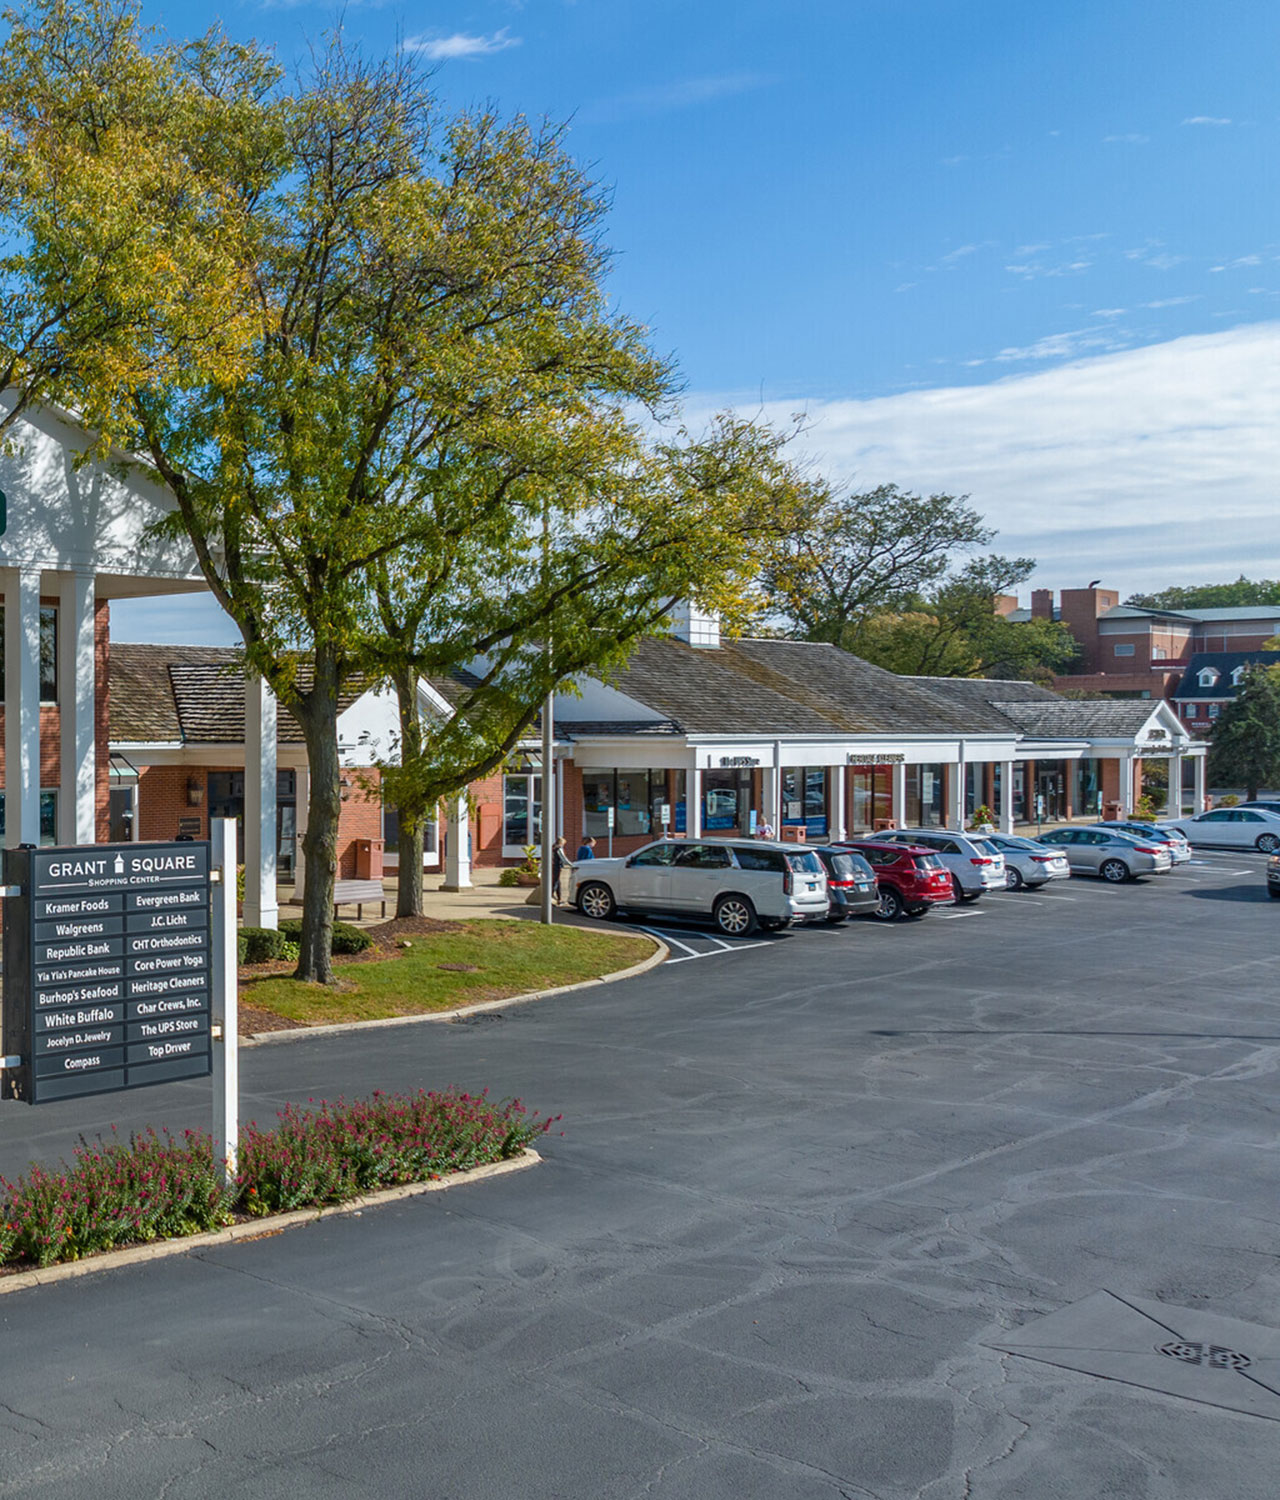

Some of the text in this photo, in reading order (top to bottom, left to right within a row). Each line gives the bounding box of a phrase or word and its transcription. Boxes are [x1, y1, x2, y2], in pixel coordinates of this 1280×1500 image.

[49, 855, 196, 877] GRANT SQUARE
[88, 875, 160, 887] SHOPPING CENTER
[45, 899, 109, 914] Kramer Foods
[136, 891, 200, 907] Evergreen Bank
[151, 914, 187, 927] J.C. Licht
[55, 923, 104, 937] Walgreens
[132, 934, 202, 950] CHT Orthodontics
[46, 942, 110, 960] Republic Bank
[134, 955, 203, 971] Core Power Yoga
[37, 966, 120, 982] Yia Yia's Pancake House
[131, 976, 205, 993] Heritage Cleaners
[39, 985, 118, 1004] Burhop's Seafood
[137, 997, 202, 1014] Char Crews, Inc.
[45, 1008, 114, 1028] White Buffalo
[141, 1019, 198, 1036] The UPS Store
[46, 1030, 112, 1048] Jocelyn D. Jewelry
[148, 1042, 191, 1057] Top Driver
[64, 1056, 100, 1069] Compass
